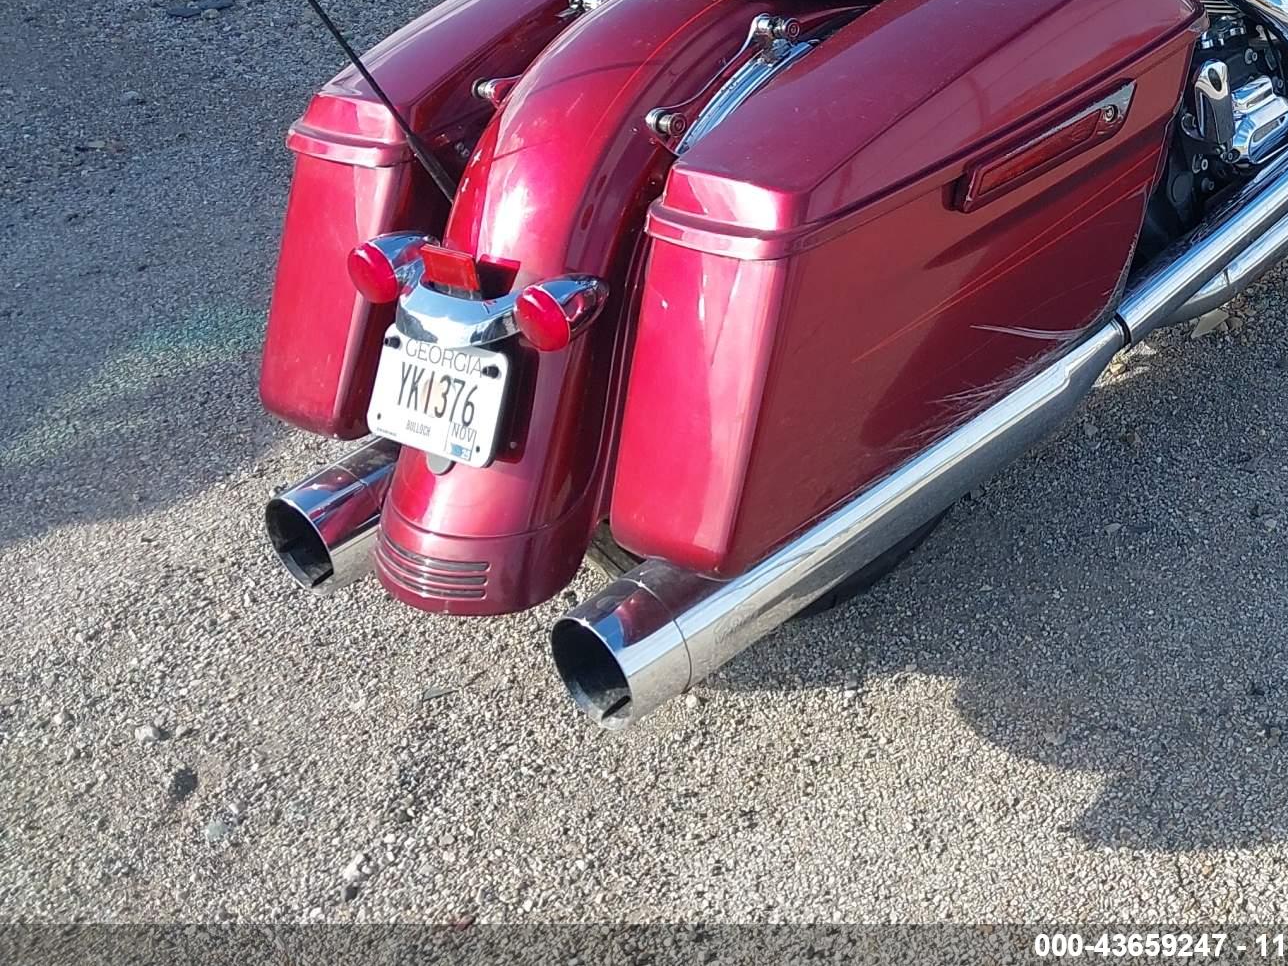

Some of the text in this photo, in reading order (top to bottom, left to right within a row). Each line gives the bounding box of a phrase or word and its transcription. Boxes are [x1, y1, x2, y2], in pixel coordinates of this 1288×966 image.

[405, 338, 482, 378] GEORGIA
[397, 361, 478, 427] YK1376
[451, 422, 475, 442] NOV
